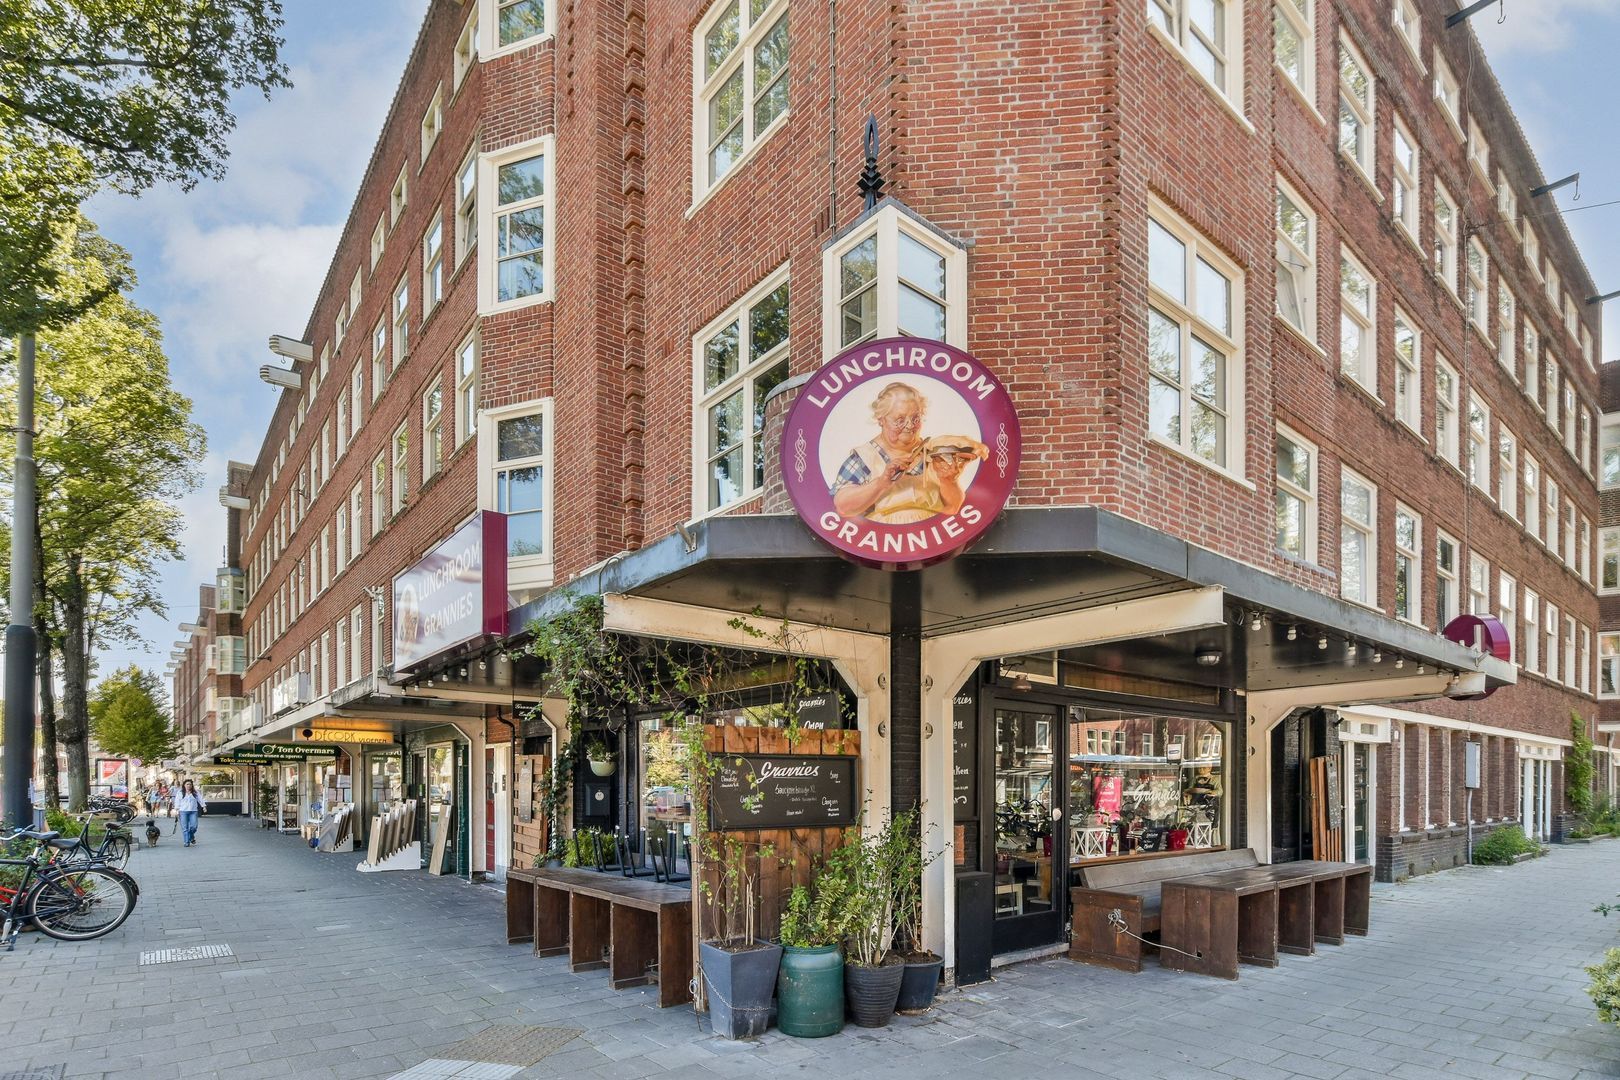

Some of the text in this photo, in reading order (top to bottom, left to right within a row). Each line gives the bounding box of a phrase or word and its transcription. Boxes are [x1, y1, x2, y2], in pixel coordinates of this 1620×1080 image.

[807, 347, 996, 409] LUNCHROOM
[820, 504, 982, 553] GRANNIES
[419, 541, 480, 600] LUNCHROOM
[424, 592, 473, 637] GRANNIES
[295, 746, 335, 754] Overmars
[756, 761, 820, 784] Grannies
[1133, 784, 1181, 809] Grannies
